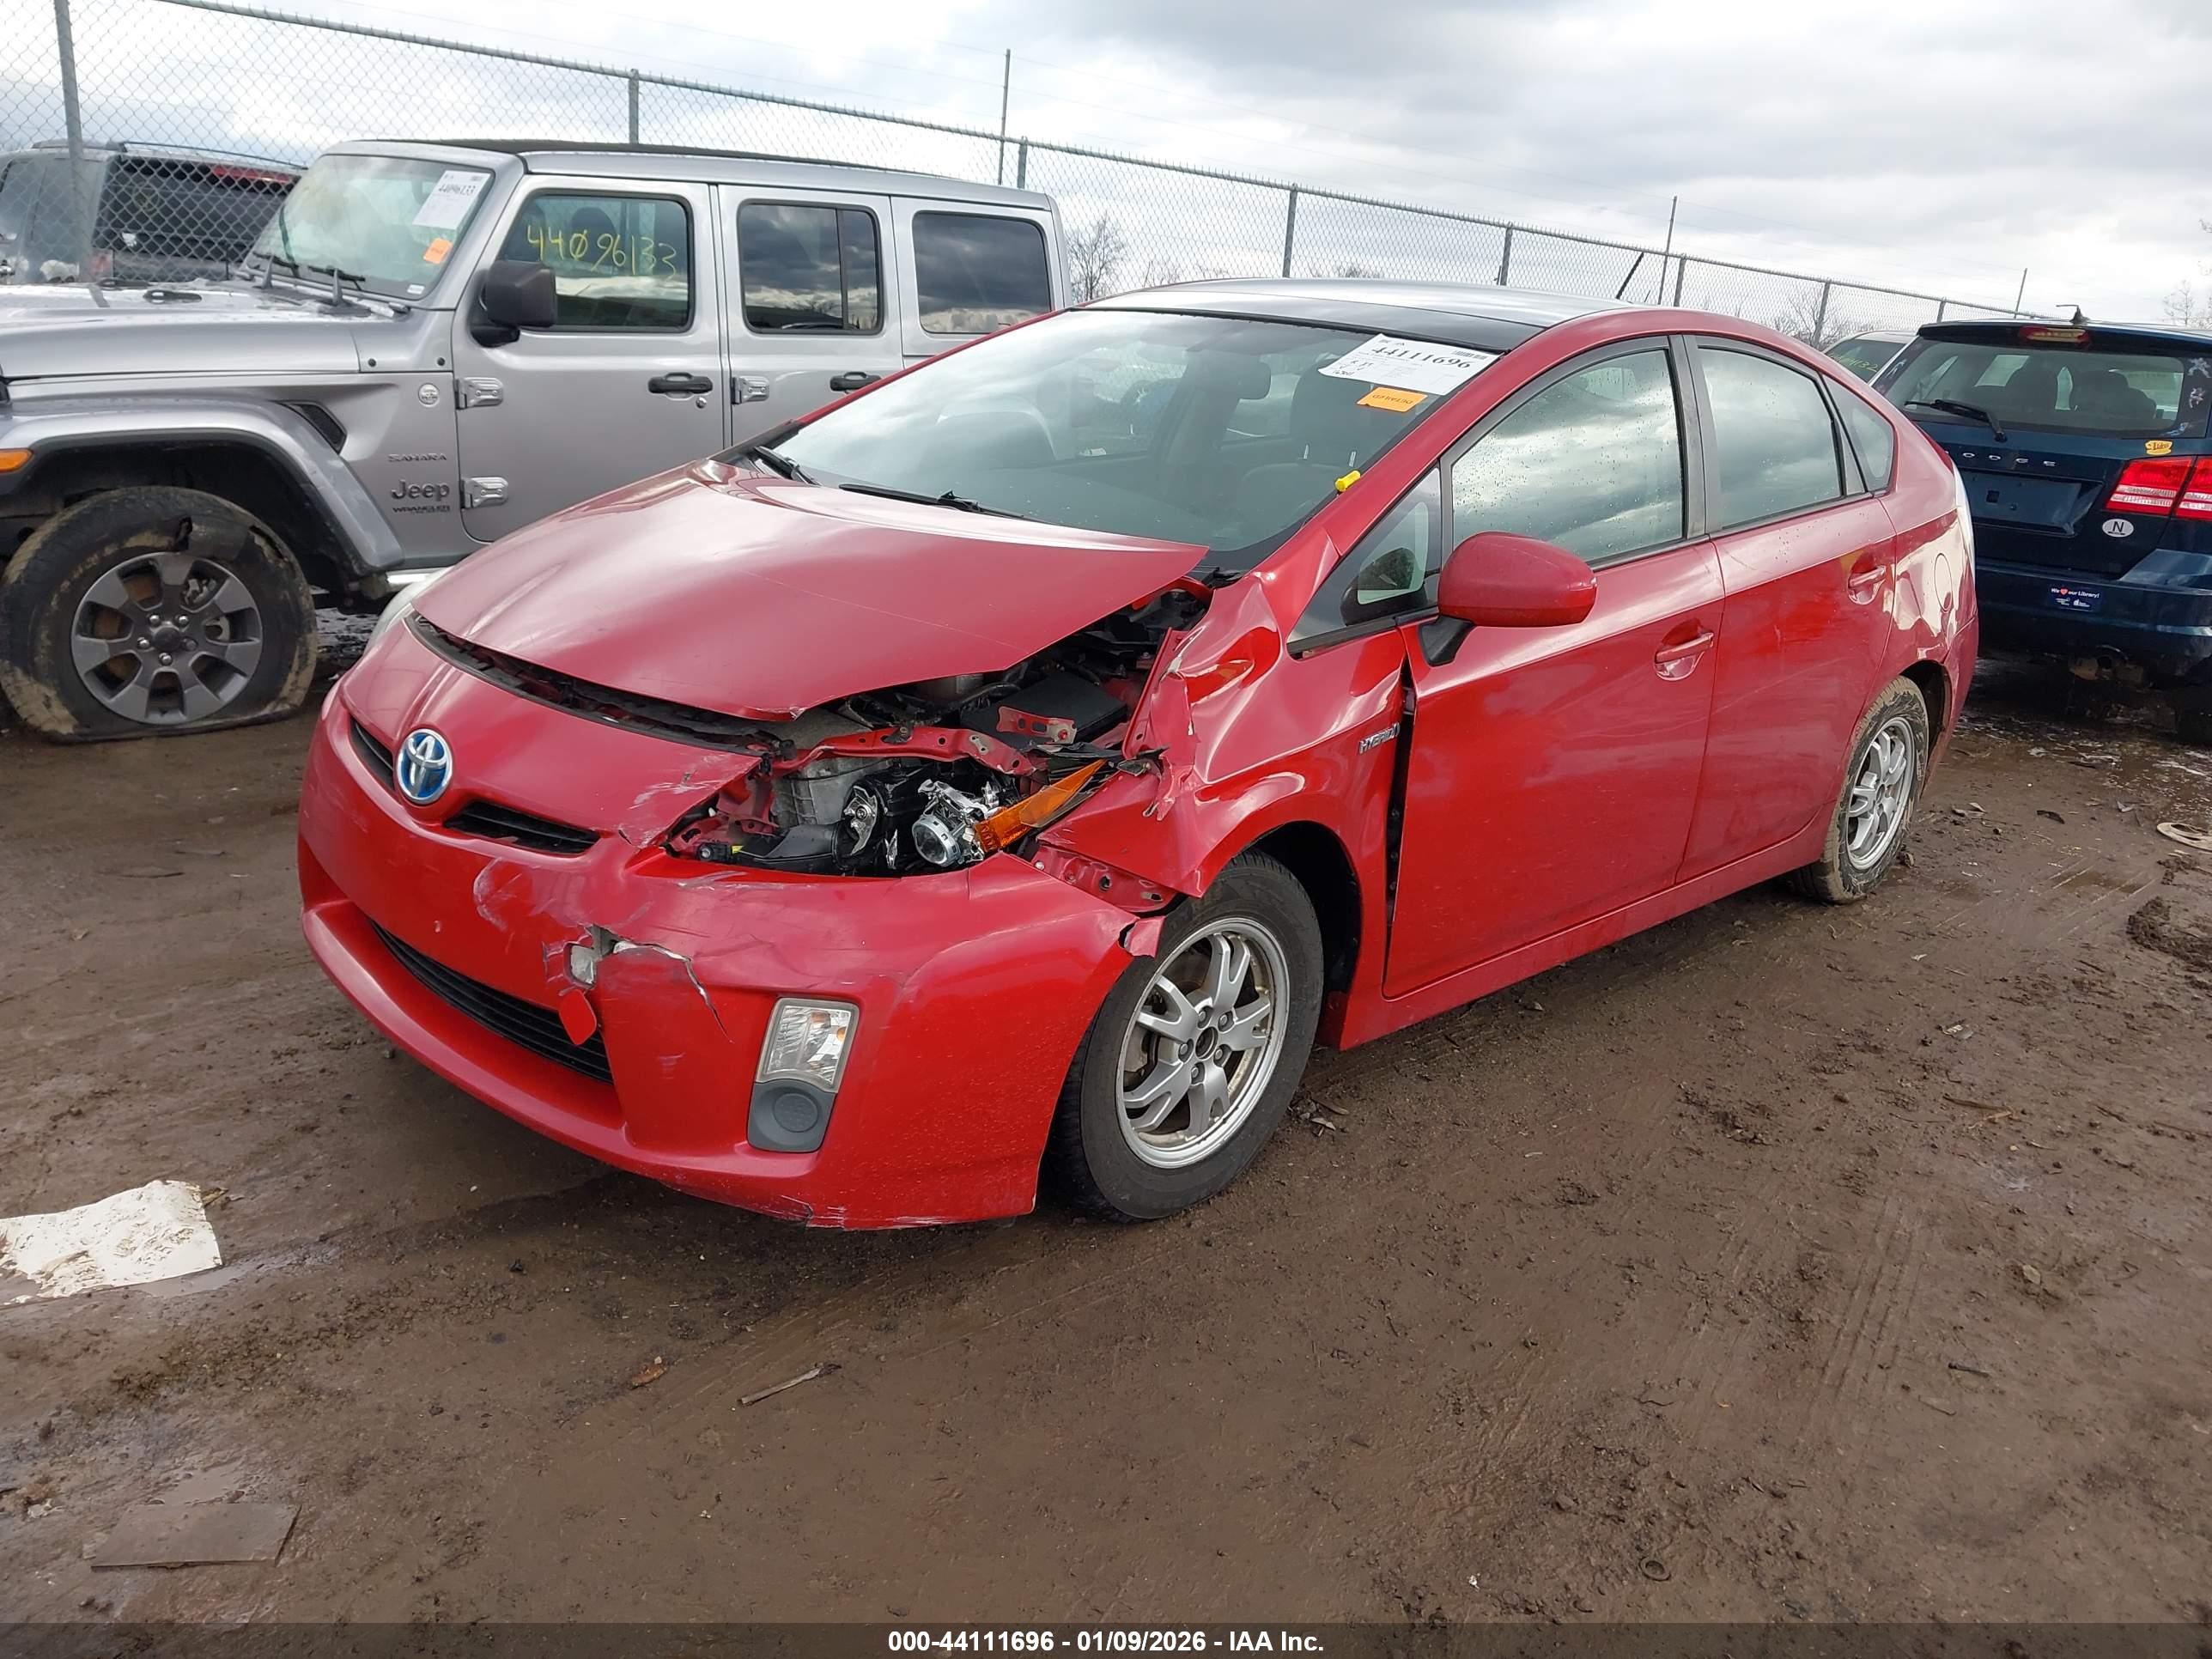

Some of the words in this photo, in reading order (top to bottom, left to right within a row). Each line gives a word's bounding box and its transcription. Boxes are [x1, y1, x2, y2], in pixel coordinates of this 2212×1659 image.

[526, 224, 678, 282] 44096133
[1371, 346, 1474, 368] 44111696
[1372, 394, 1414, 404] DETAILED
[387, 453, 447, 462] SAHARA
[1944, 449, 2057, 467] ODGE
[391, 478, 451, 502] Jeep
[2112, 520, 2125, 532] N
[1358, 721, 1401, 755] HYBRID
